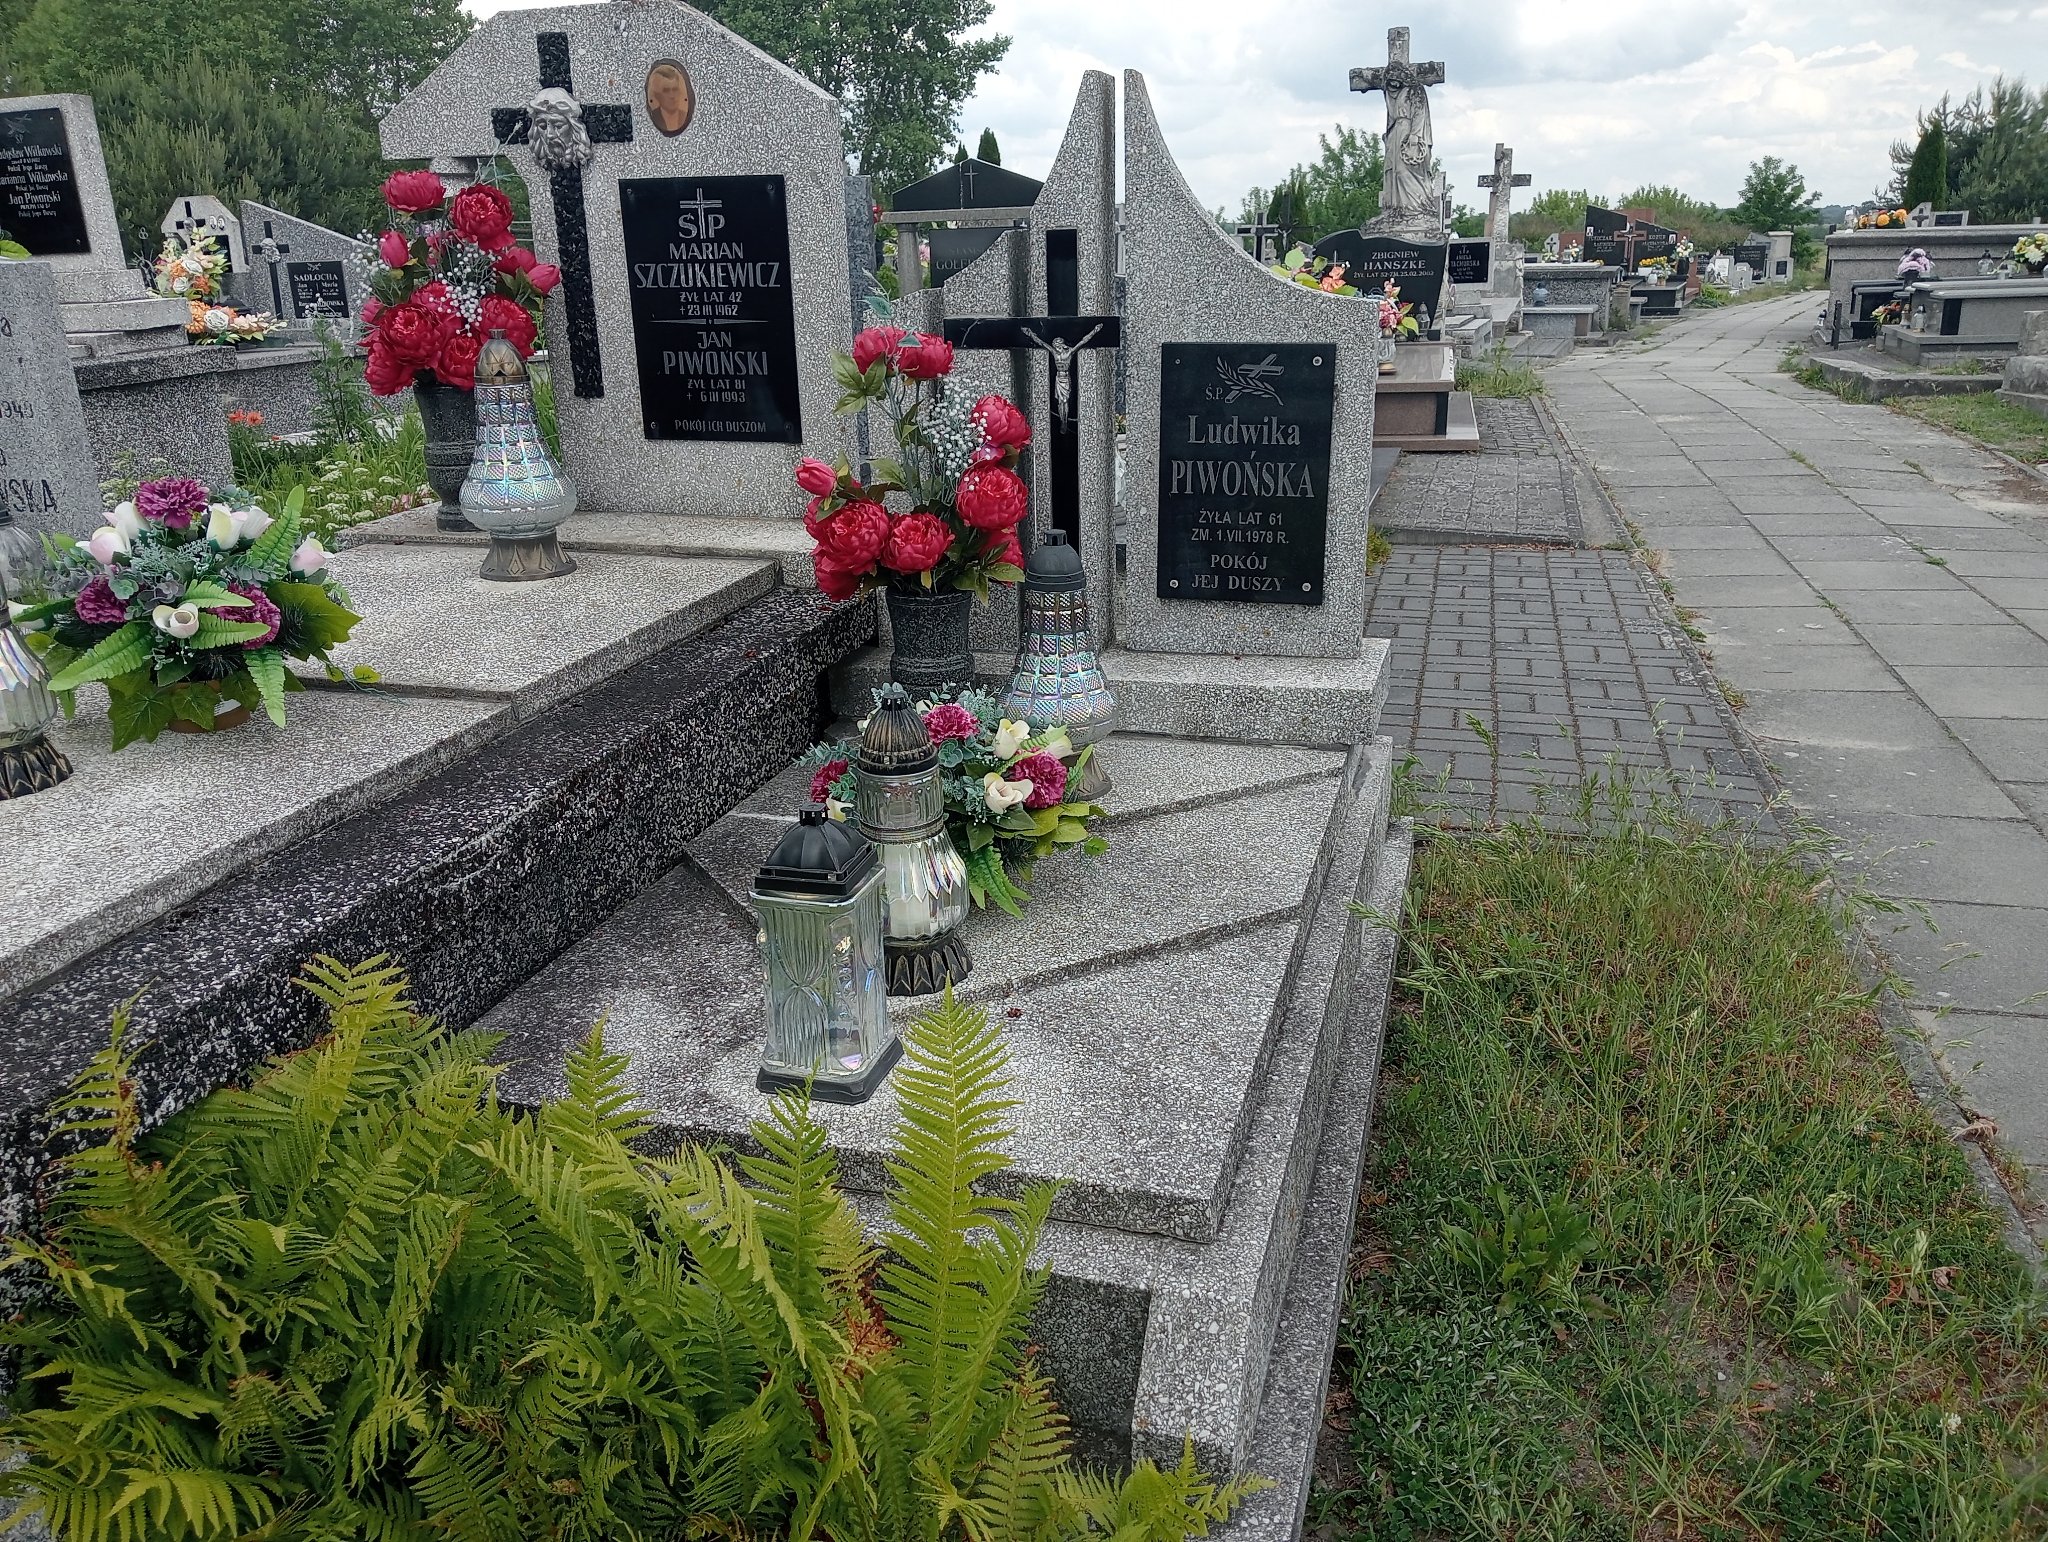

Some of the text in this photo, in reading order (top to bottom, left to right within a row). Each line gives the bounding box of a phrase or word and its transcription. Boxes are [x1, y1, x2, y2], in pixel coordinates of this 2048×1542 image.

[8, 193, 24, 204] Jan
[669, 242, 744, 260] MARIAN
[1371, 250, 1420, 260] ZBIGNIEW
[1364, 260, 1426, 271] HANSZKE
[634, 262, 781, 288] SZCZUKIEWICZ
[703, 291, 725, 303] LAT
[728, 291, 743, 303] 42
[687, 304, 739, 316] 23 III 1962
[697, 331, 732, 349] JAN
[663, 349, 768, 376] PIWOŃSKI
[710, 378, 731, 389] LAT
[734, 379, 746, 390] 81
[700, 391, 707, 402] 6
[721, 391, 746, 403] 1993
[674, 419, 767, 433] POKÓJ ICH DUSZOM
[1187, 415, 1301, 446] Ludwika
[1170, 450, 1315, 498] PIWOŃSKA
[1198, 508, 1282, 526] ŻYŁA LAT 61
[1191, 528, 1289, 544] ZM. 1.VII.1978 R.
[1210, 552, 1269, 570] POKÓJ
[1191, 574, 1286, 591] JEJ DUSZY
